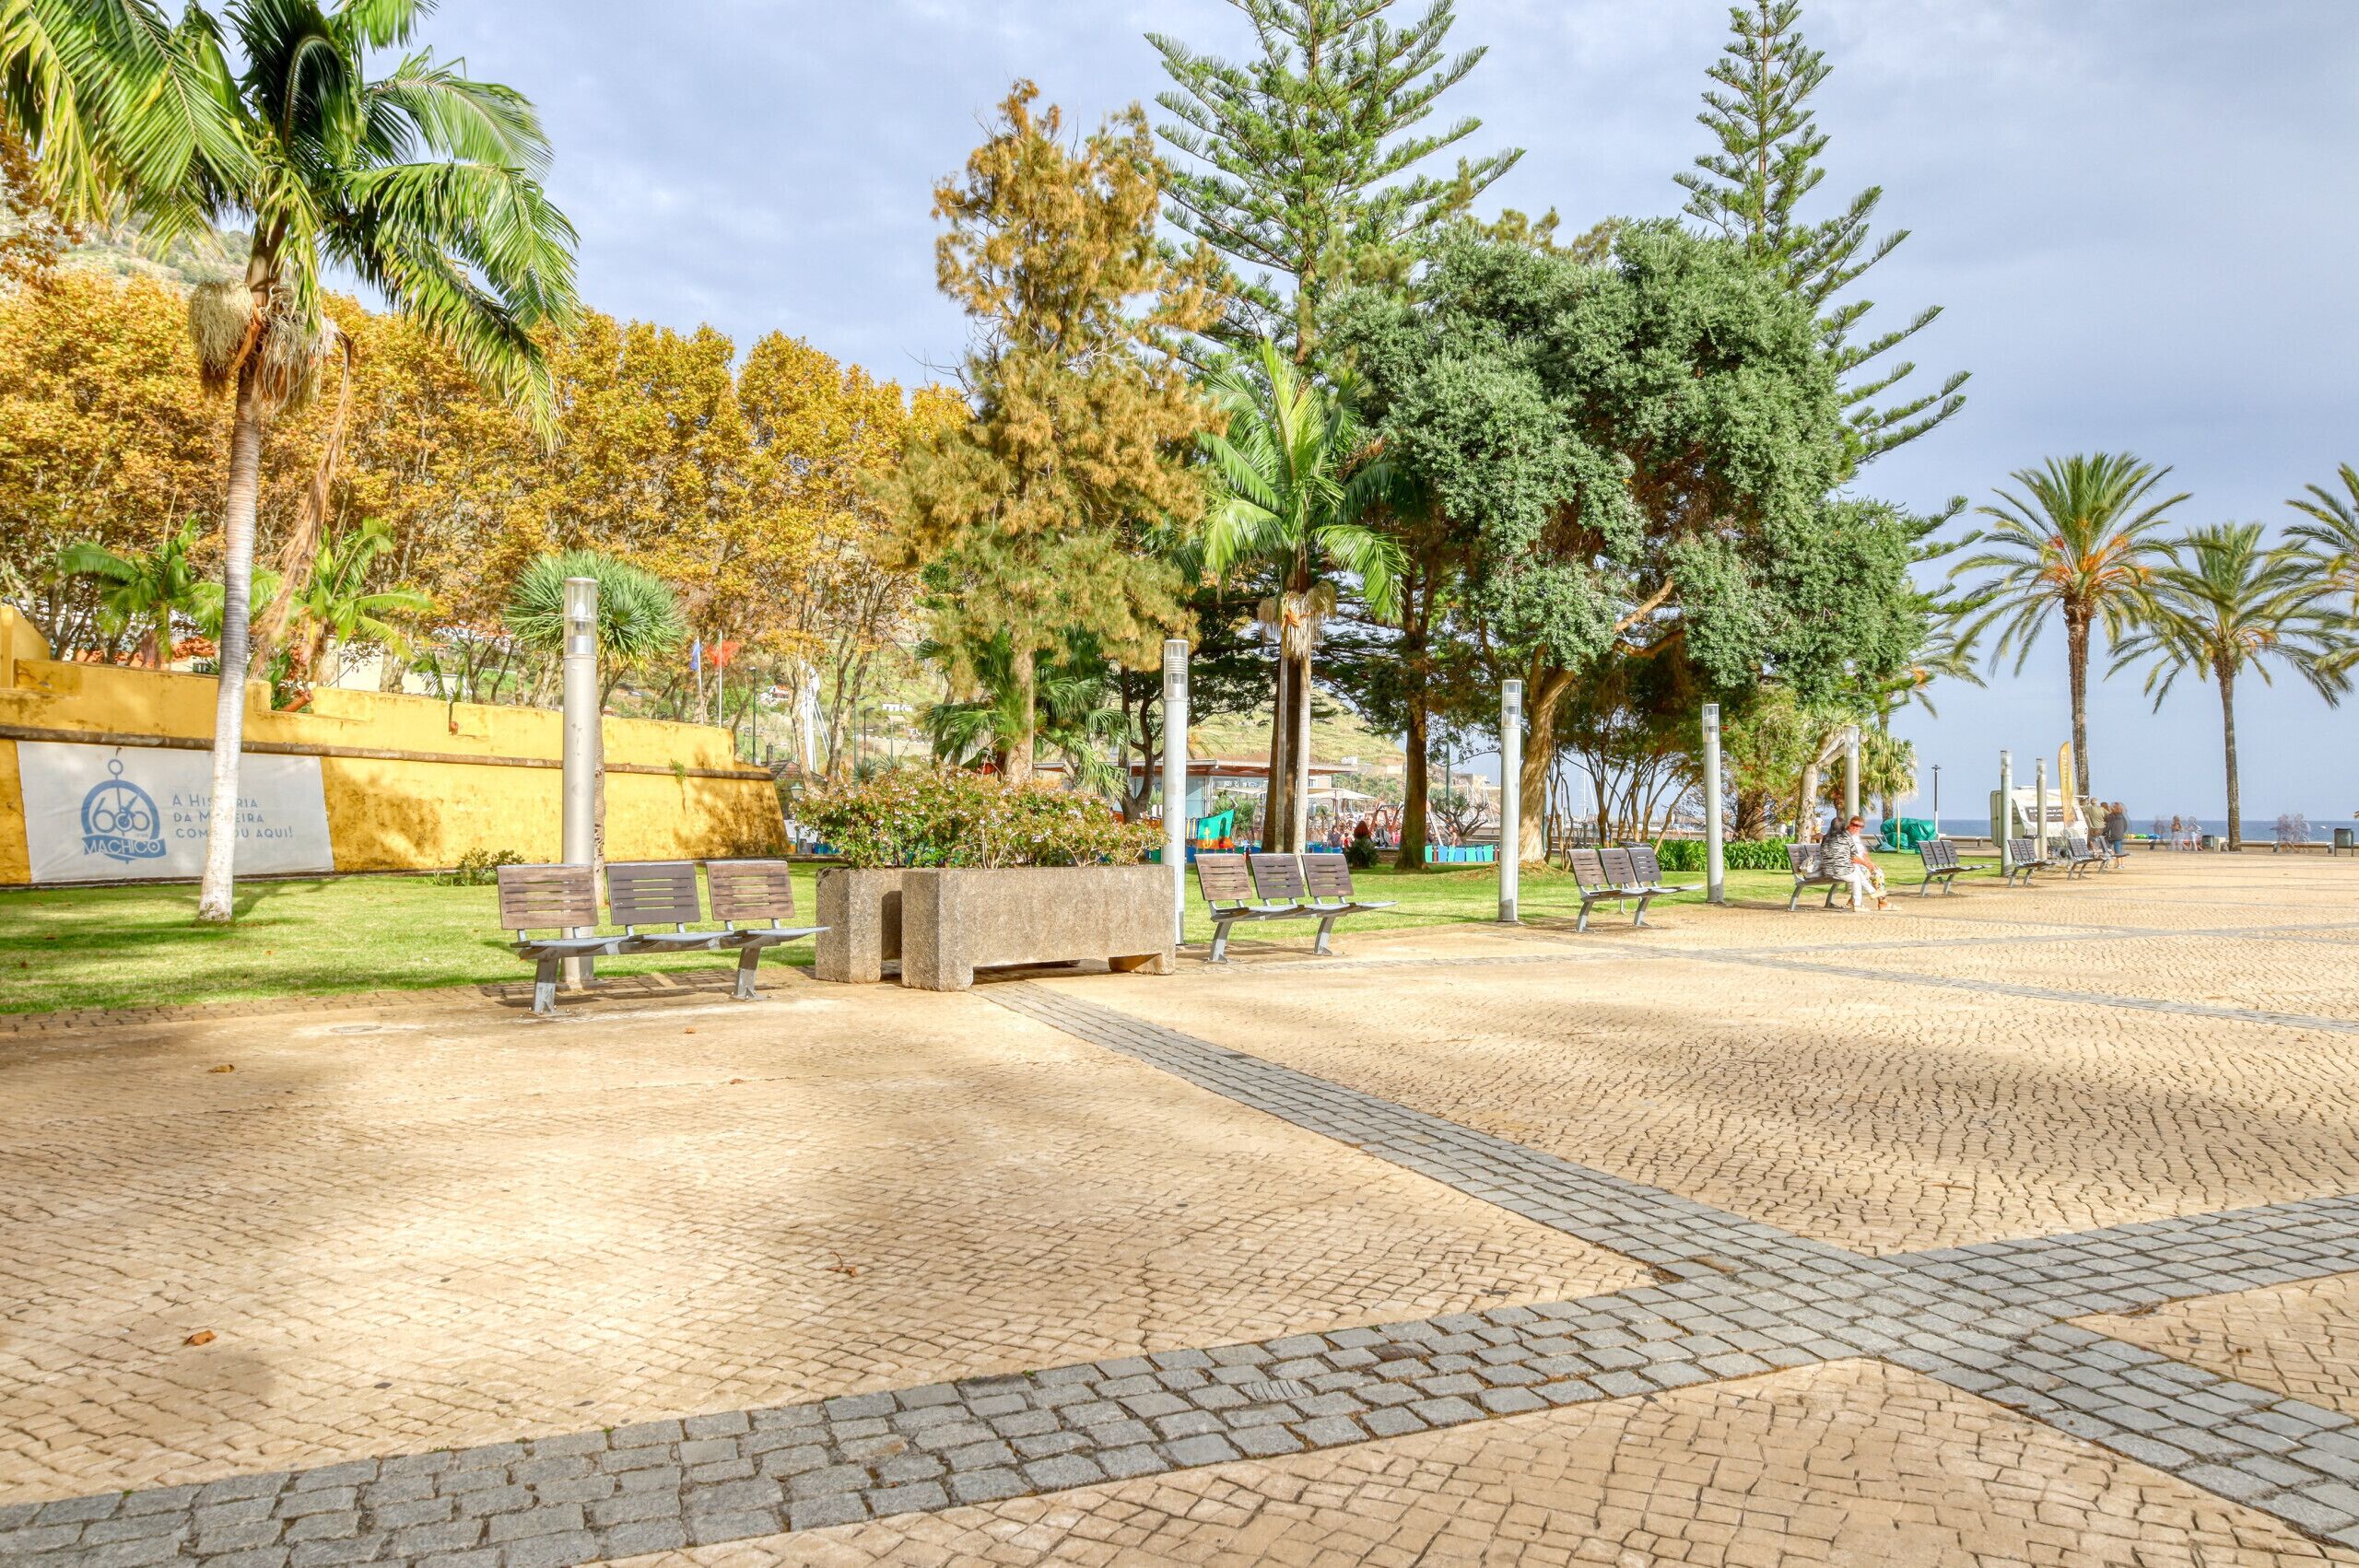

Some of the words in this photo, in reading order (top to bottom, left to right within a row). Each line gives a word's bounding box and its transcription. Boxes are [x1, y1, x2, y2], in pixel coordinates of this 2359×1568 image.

[172, 794, 182, 806] A
[189, 793, 258, 808] HISRIA
[174, 813, 192, 823] DA
[199, 811, 264, 823] MEIRA
[256, 825, 294, 838] AQUI!
[83, 839, 160, 855] MACHICO
